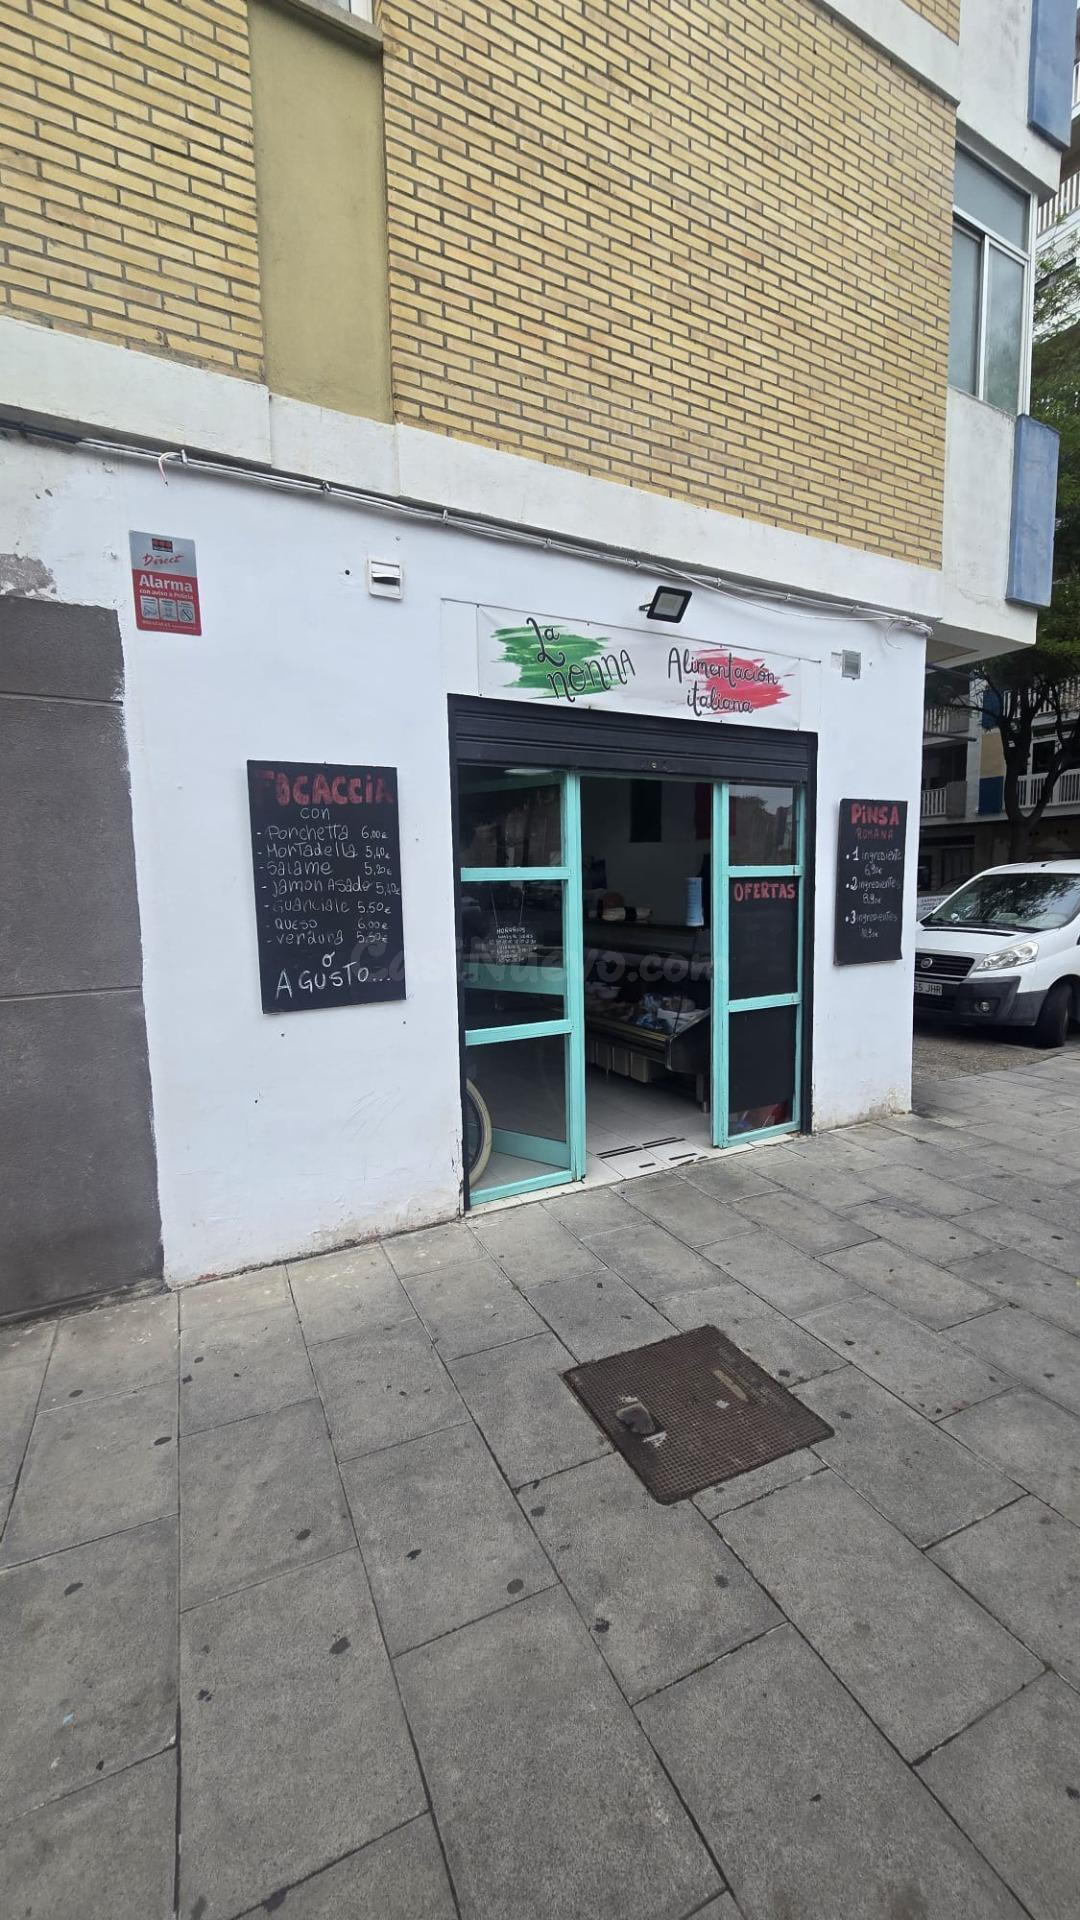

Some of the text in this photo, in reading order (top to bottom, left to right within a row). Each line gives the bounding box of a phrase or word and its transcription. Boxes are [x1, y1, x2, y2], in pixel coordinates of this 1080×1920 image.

[139, 574, 193, 593] Alarma
[526, 617, 560, 668] La
[667, 647, 780, 687] Alimentación
[687, 681, 754, 716] italiana
[300, 807, 331, 820] con
[852, 846, 860, 861] 1
[266, 861, 333, 876] Salame
[327, 875, 373, 892] Asado
[733, 881, 796, 902] OFERTAS
[850, 876, 858, 891] 2
[850, 910, 857, 925] 3
[276, 967, 293, 999] A
[925, 983, 941, 994] JHR
